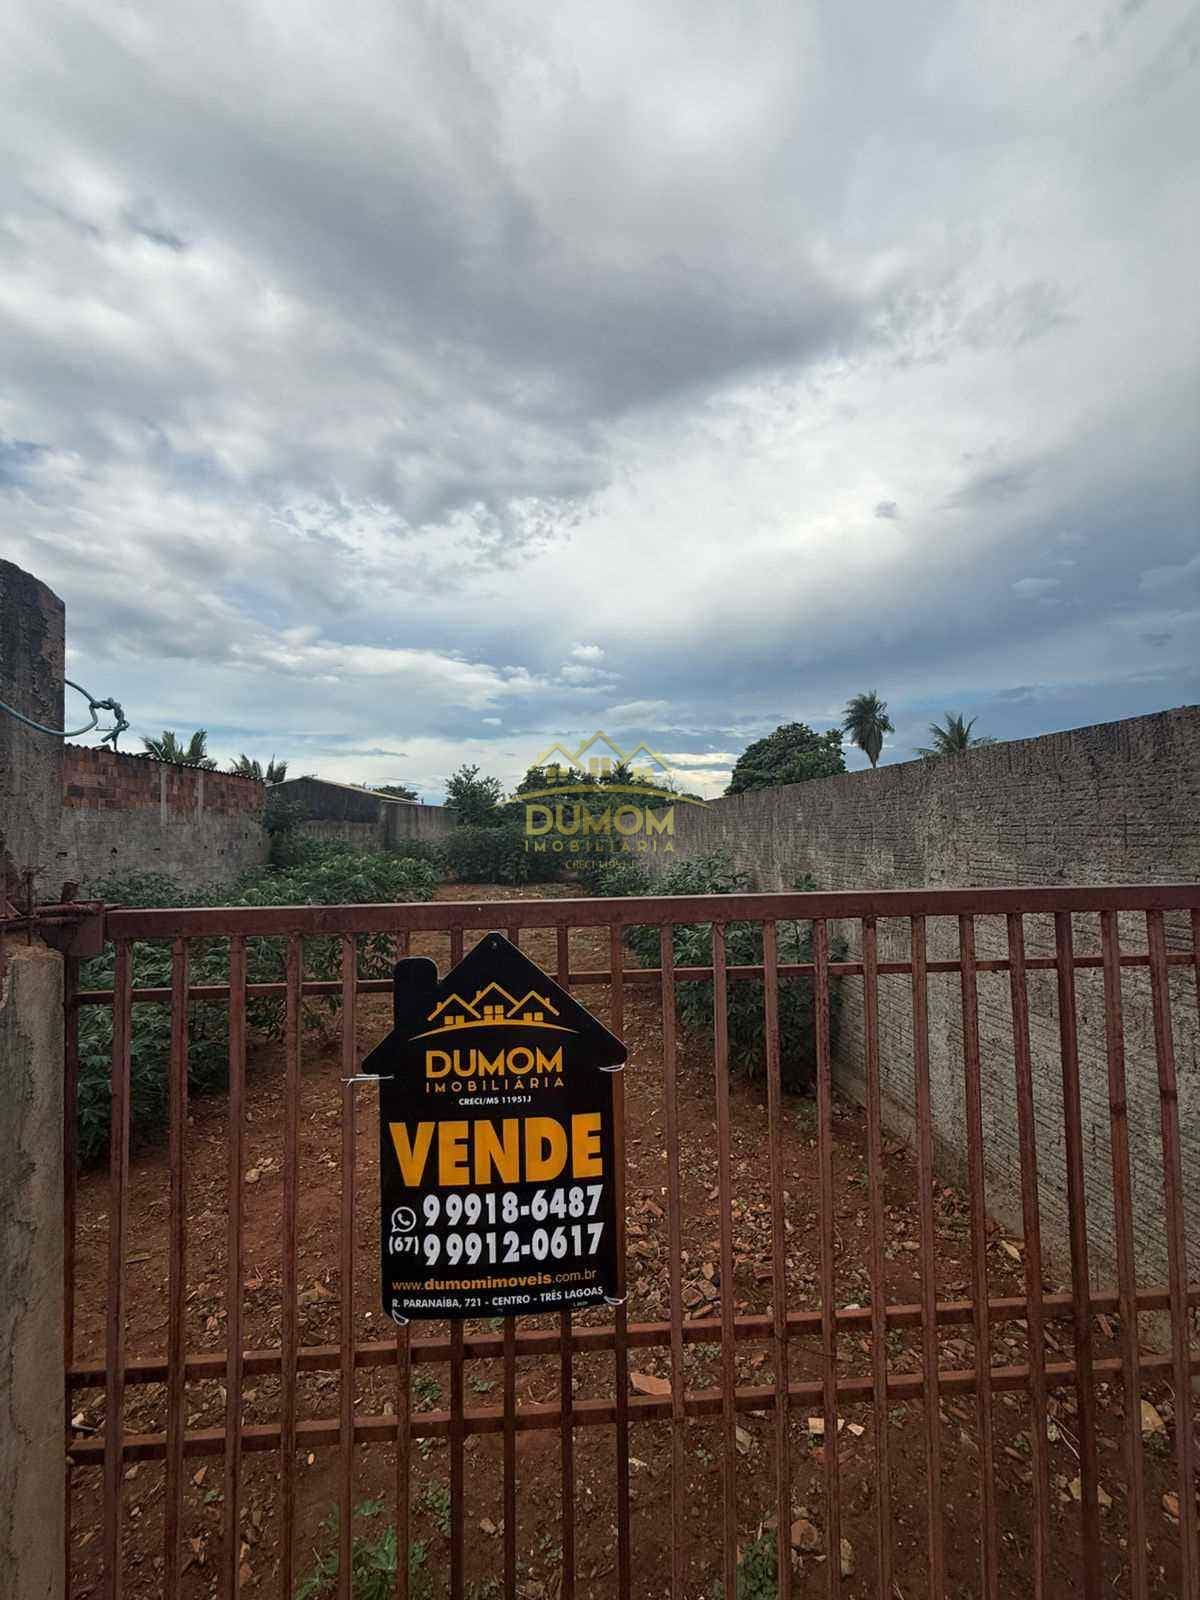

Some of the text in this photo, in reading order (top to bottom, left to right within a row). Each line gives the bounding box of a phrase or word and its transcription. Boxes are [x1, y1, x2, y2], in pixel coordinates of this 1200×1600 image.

[426, 1046, 563, 1078] DUMOM
[426, 1076, 564, 1093] IMOBILIÁRIA
[458, 1095, 532, 1106] CRECI/MS 11951J
[388, 1113, 604, 1188] VENDE
[388, 1235, 420, 1255] (67)
[392, 1269, 597, 1290] www.dumomimoveis.com.br
[392, 1299, 401, 1308] R.
[403, 1297, 462, 1308] PARANAÍBA,
[465, 1298, 481, 1307] 721
[492, 1295, 530, 1306] CENTRO
[540, 1291, 562, 1302] TRÊS
[565, 1286, 604, 1299] LAGOAS
